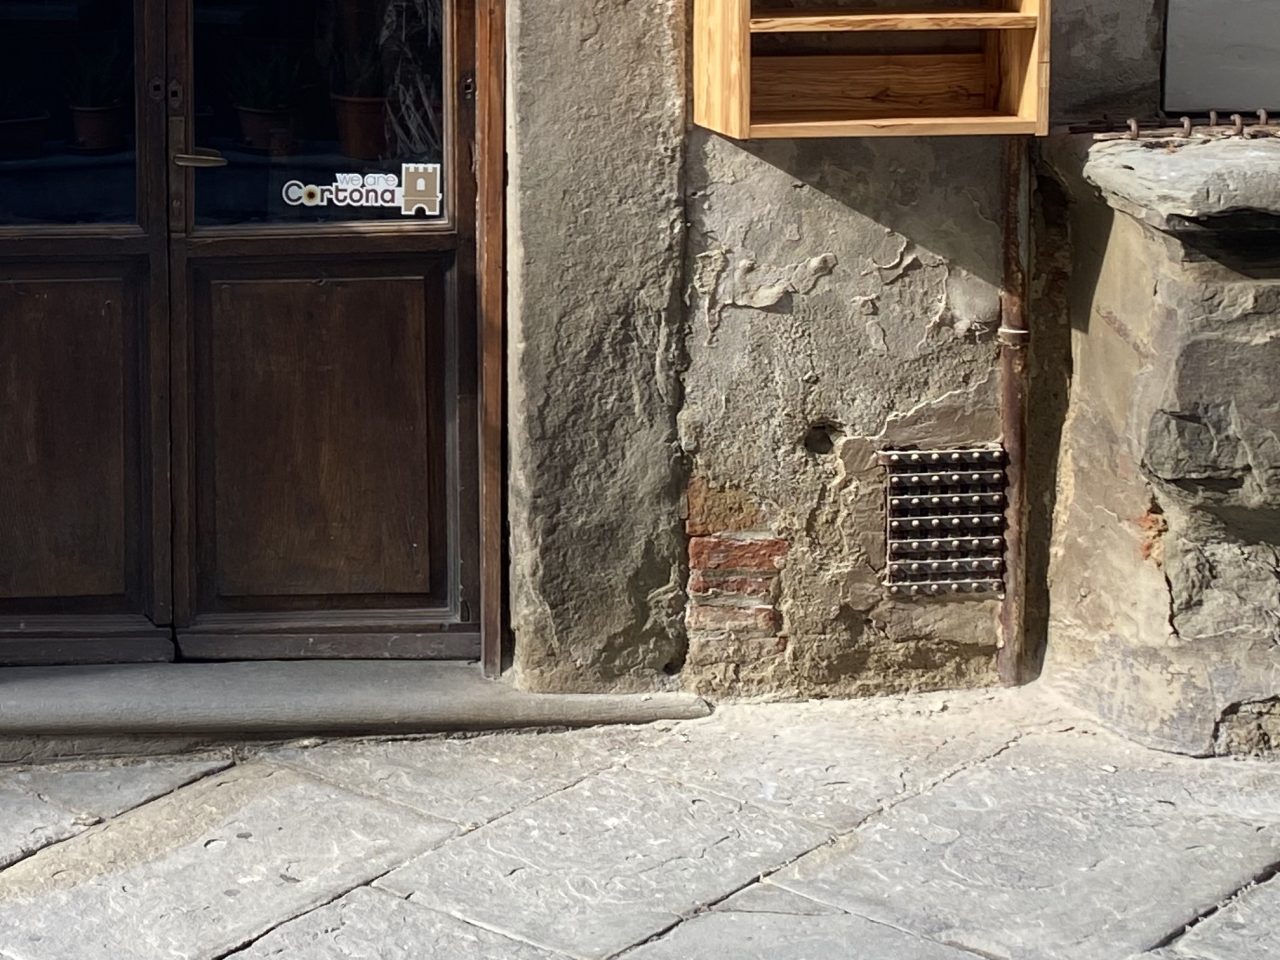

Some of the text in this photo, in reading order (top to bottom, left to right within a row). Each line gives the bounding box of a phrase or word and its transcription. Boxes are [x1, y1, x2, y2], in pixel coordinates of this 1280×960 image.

[338, 174, 396, 187] we are
[284, 182, 396, 205] Cortona
